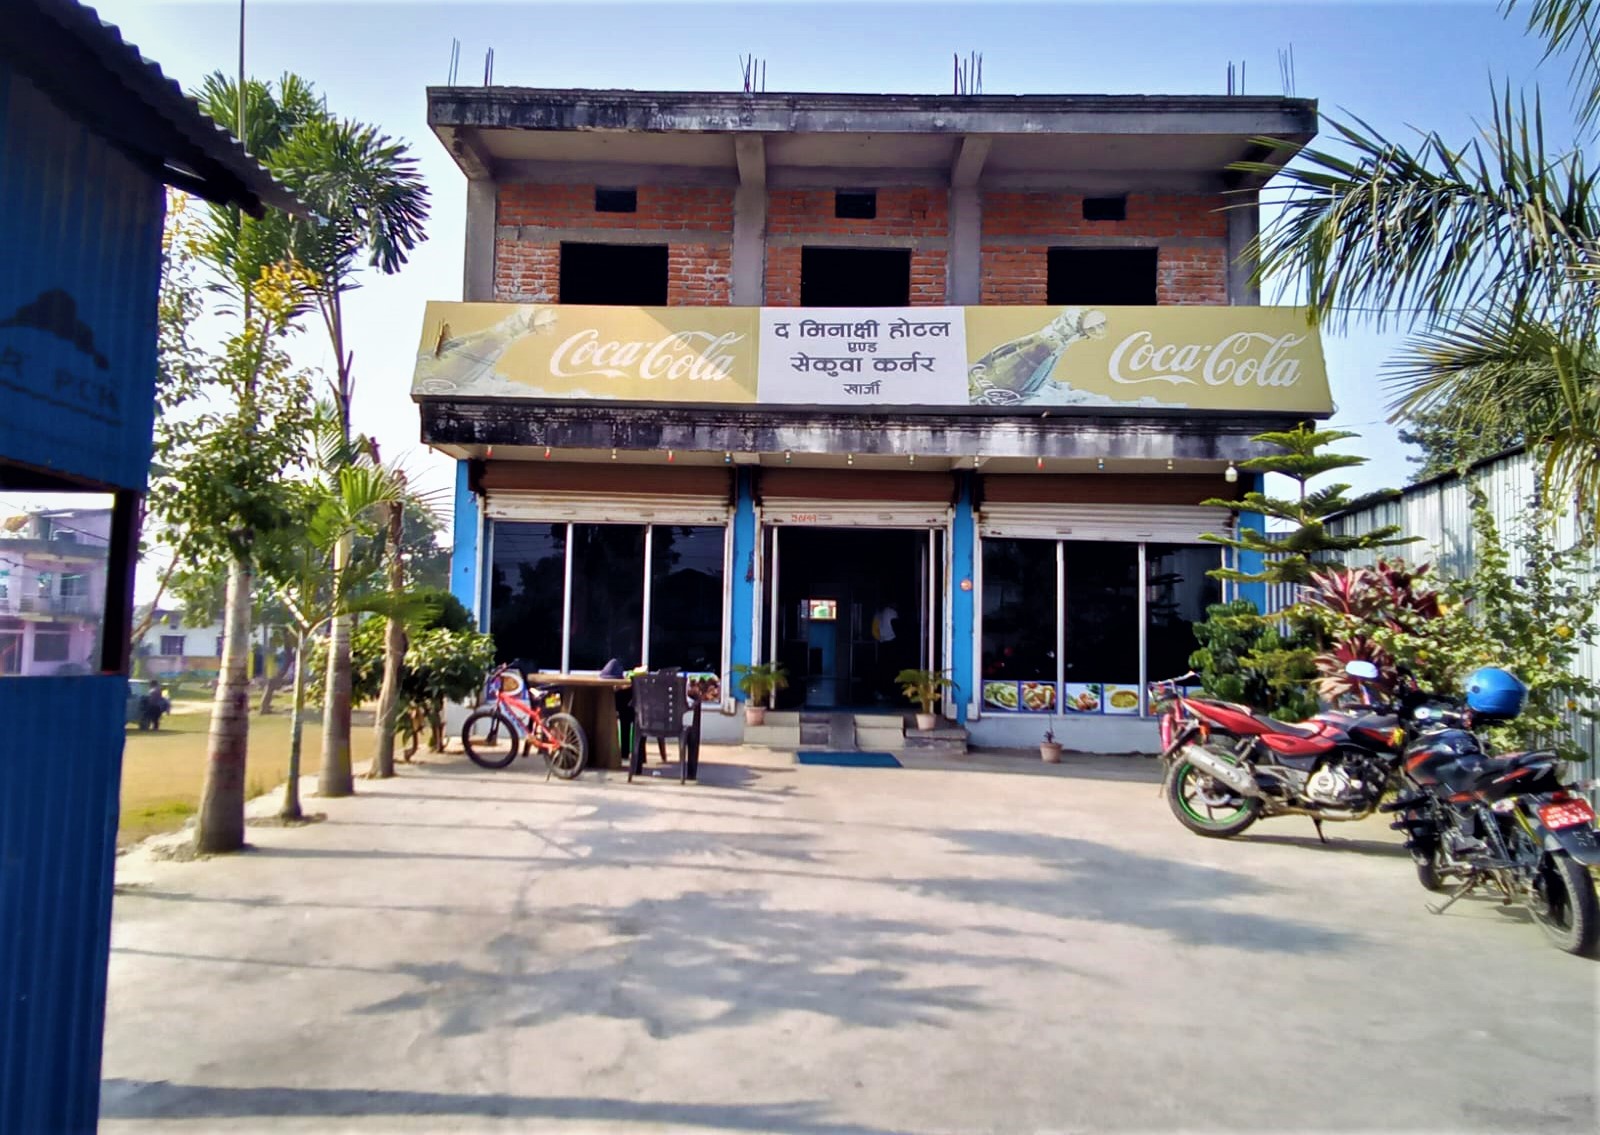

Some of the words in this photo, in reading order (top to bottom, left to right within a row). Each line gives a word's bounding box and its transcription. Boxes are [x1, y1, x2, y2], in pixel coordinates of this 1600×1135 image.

[774, 322, 791, 340] द
[800, 319, 880, 339] मिनाक्षी
[888, 318, 951, 339] होटल
[550, 329, 746, 381] Coca-Cola
[790, 352, 863, 377] सेकुवा
[872, 351, 936, 373] कर्नर
[1108, 331, 1307, 387] Coca-Cola
